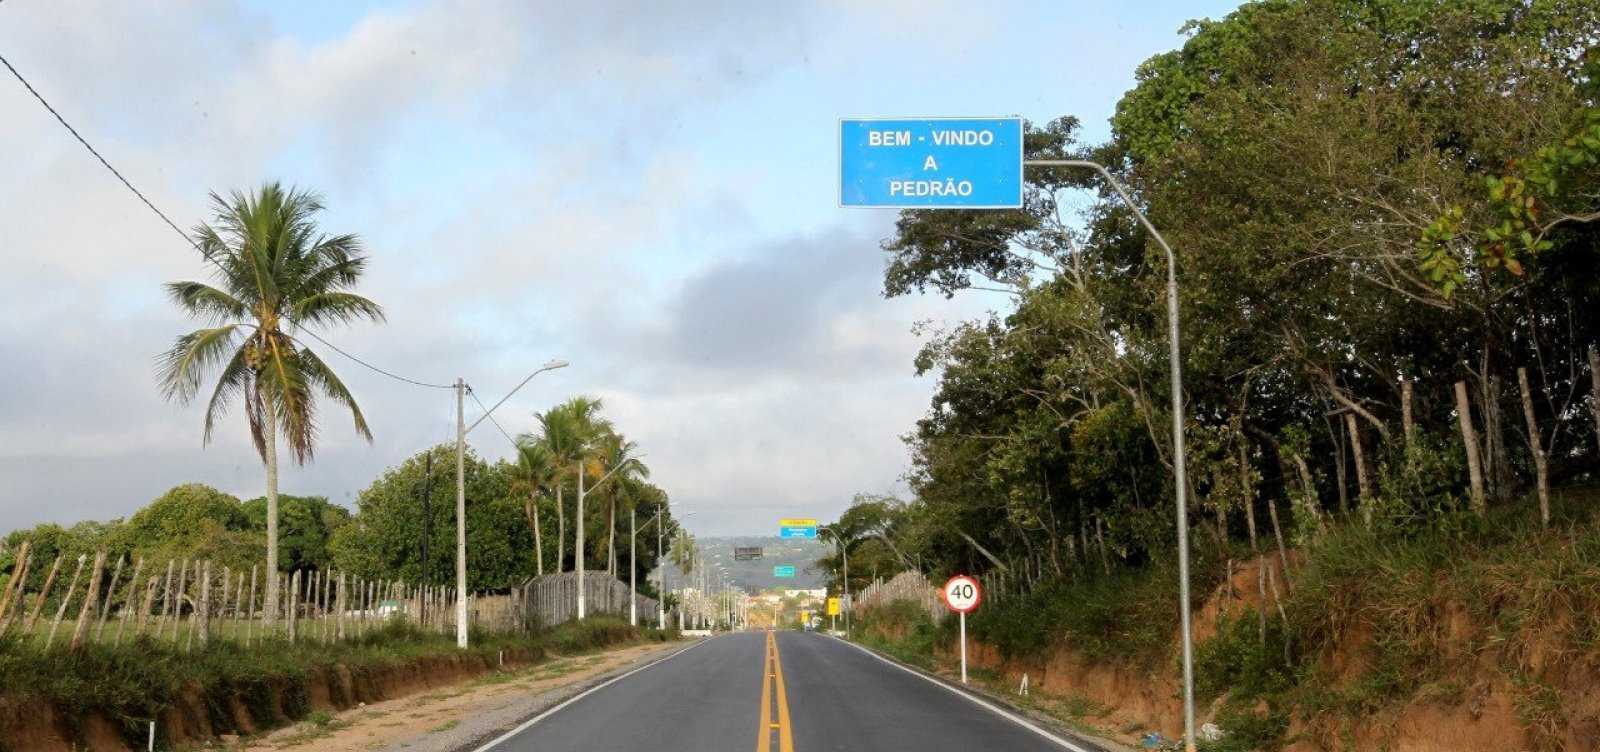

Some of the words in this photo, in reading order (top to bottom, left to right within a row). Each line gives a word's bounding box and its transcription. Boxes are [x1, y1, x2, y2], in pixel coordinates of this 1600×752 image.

[869, 131, 911, 146] BEM
[932, 130, 994, 145] VINDO
[923, 155, 938, 171] A
[890, 178, 973, 196] PEDRÃO
[951, 584, 973, 599] 40
